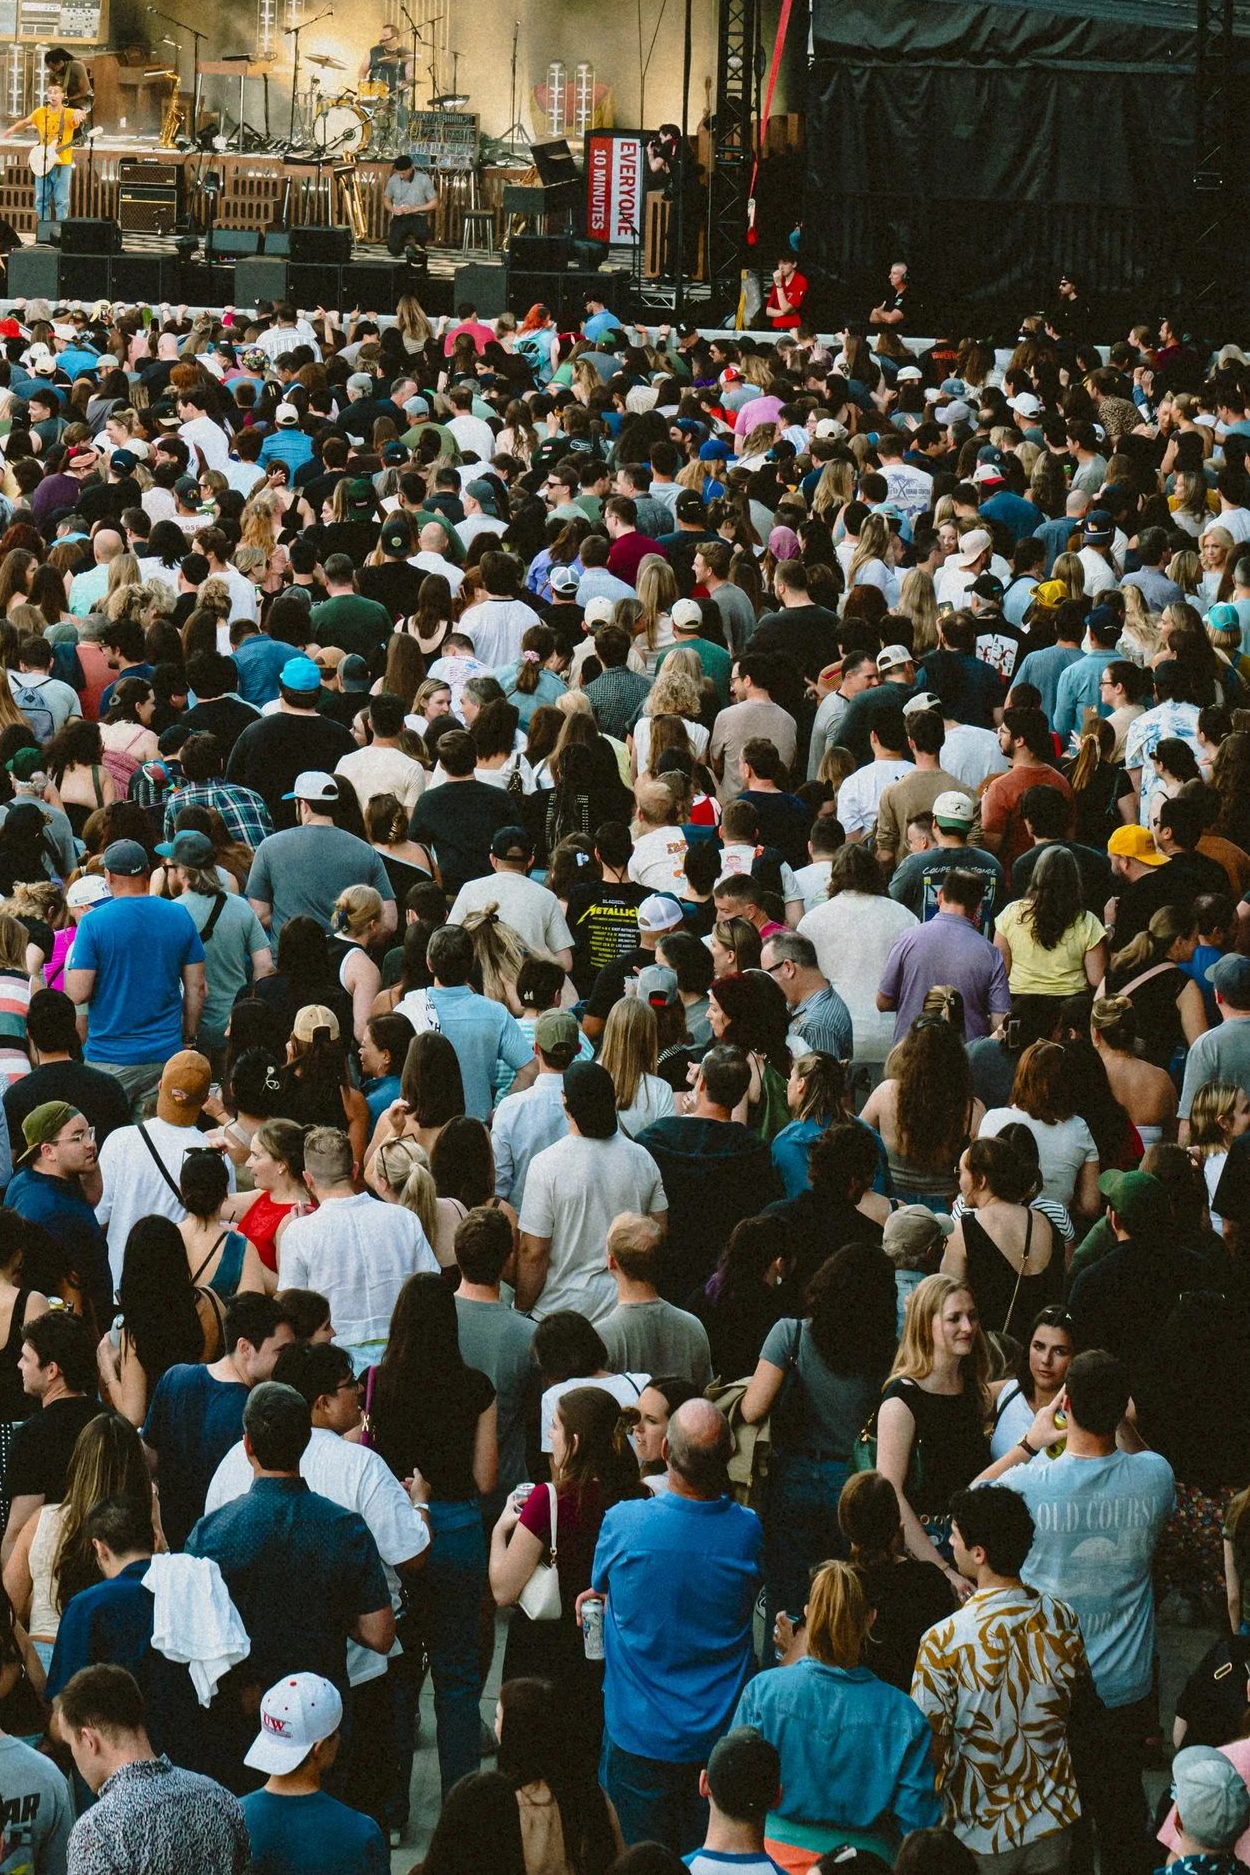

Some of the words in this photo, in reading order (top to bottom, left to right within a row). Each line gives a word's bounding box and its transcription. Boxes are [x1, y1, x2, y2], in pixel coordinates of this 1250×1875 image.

[594, 149, 607, 166] 10
[592, 170, 606, 230] MINUTES
[617, 141, 637, 237] EVERYONE
[1037, 1501, 1080, 1533] OLD
[263, 1711, 287, 1733] UW
[4, 1793, 41, 1825] AR
